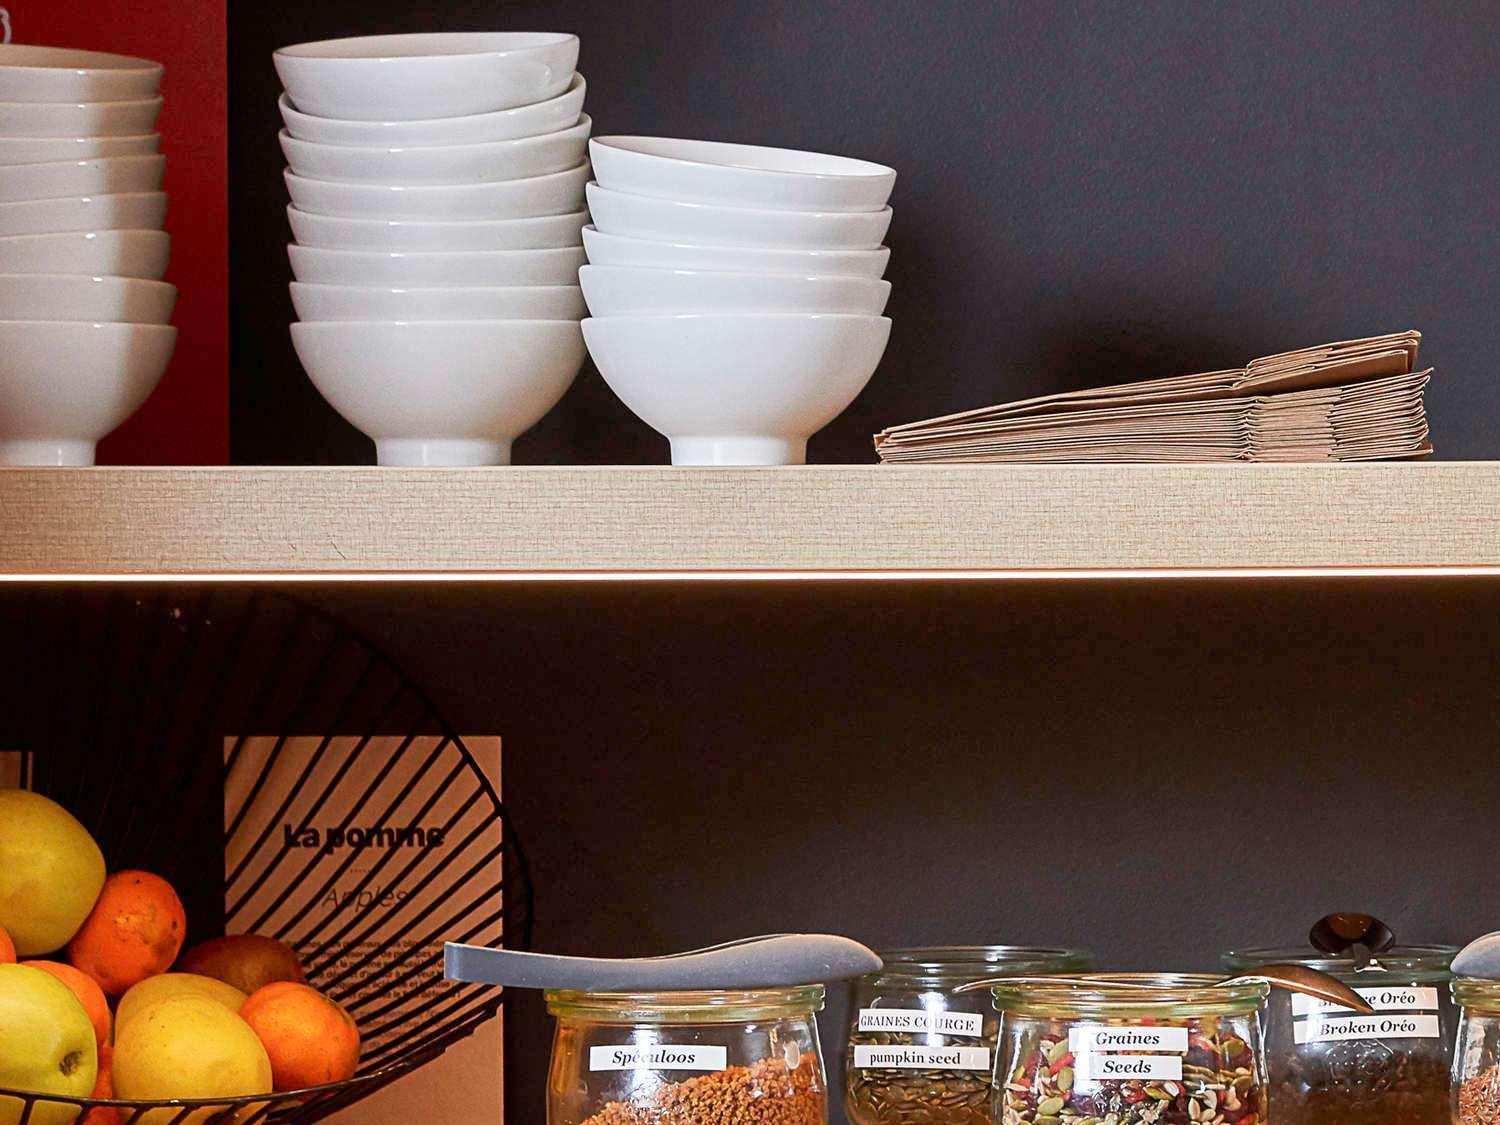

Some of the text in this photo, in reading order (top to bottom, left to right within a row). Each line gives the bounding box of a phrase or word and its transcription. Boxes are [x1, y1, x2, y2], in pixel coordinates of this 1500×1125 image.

[284, 824, 445, 855] La pomme
[1380, 991, 1416, 1004] Oréo
[861, 1015, 911, 1028] GRAINES
[1321, 1019, 1416, 1036] Broken Oréo
[1096, 1031, 1160, 1045] Graines
[612, 1050, 696, 1066] Spéculoos
[870, 1051, 961, 1066] pumpkin seed
[1103, 1060, 1152, 1073] Seeds
